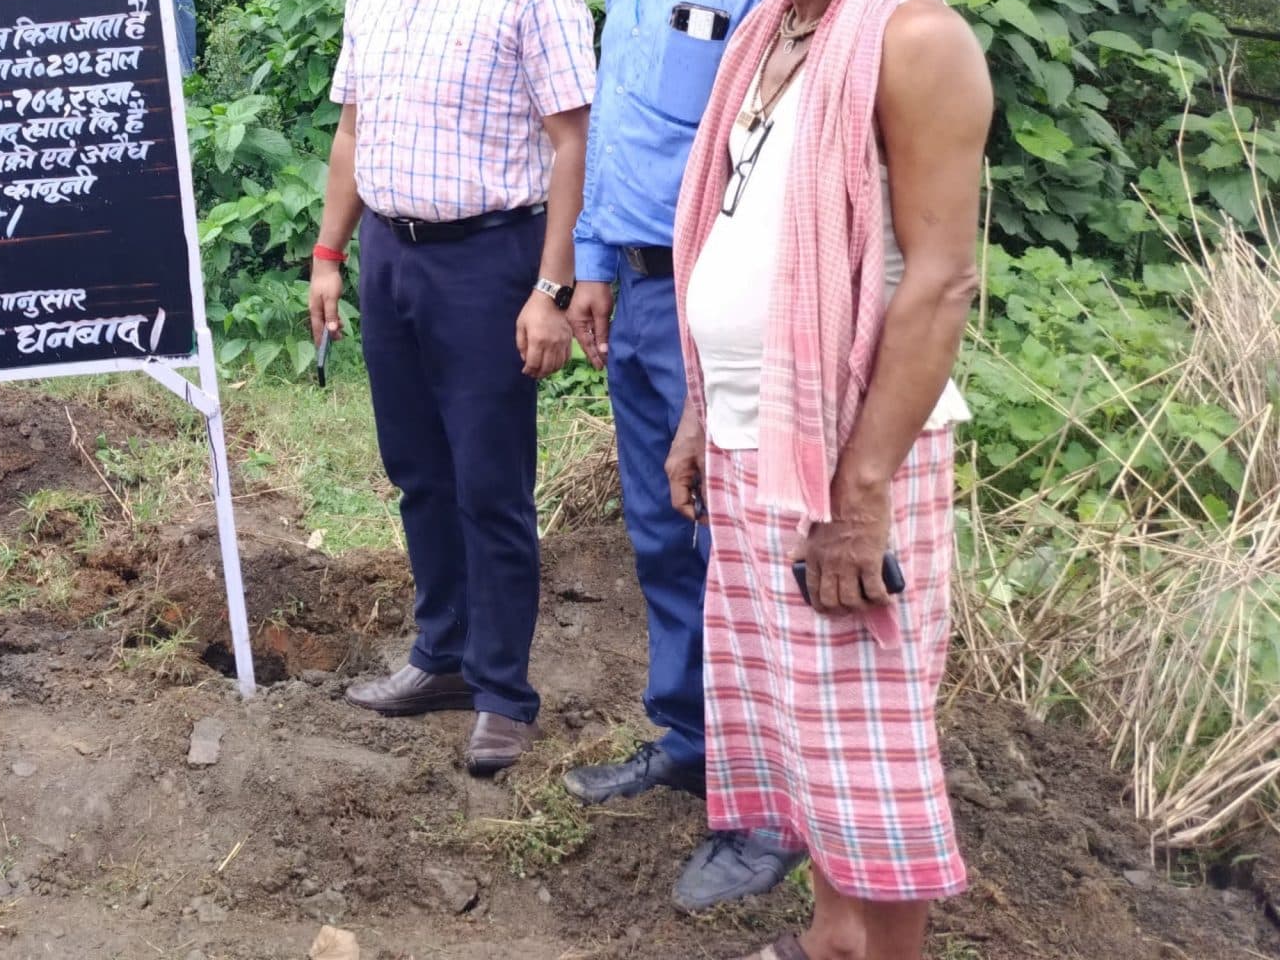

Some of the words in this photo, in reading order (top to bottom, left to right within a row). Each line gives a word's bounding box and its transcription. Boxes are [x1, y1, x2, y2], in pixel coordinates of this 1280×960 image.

[13, 16, 70, 50] किया
[70, 13, 127, 41] जाता
[46, 51, 93, 77] 292
[95, 46, 143, 77] हाल
[89, 109, 120, 135] कि
[125, 99, 149, 133] है
[40, 140, 77, 170] एवं
[80, 133, 155, 164] अवैध
[4, 166, 98, 203] कानूनी
